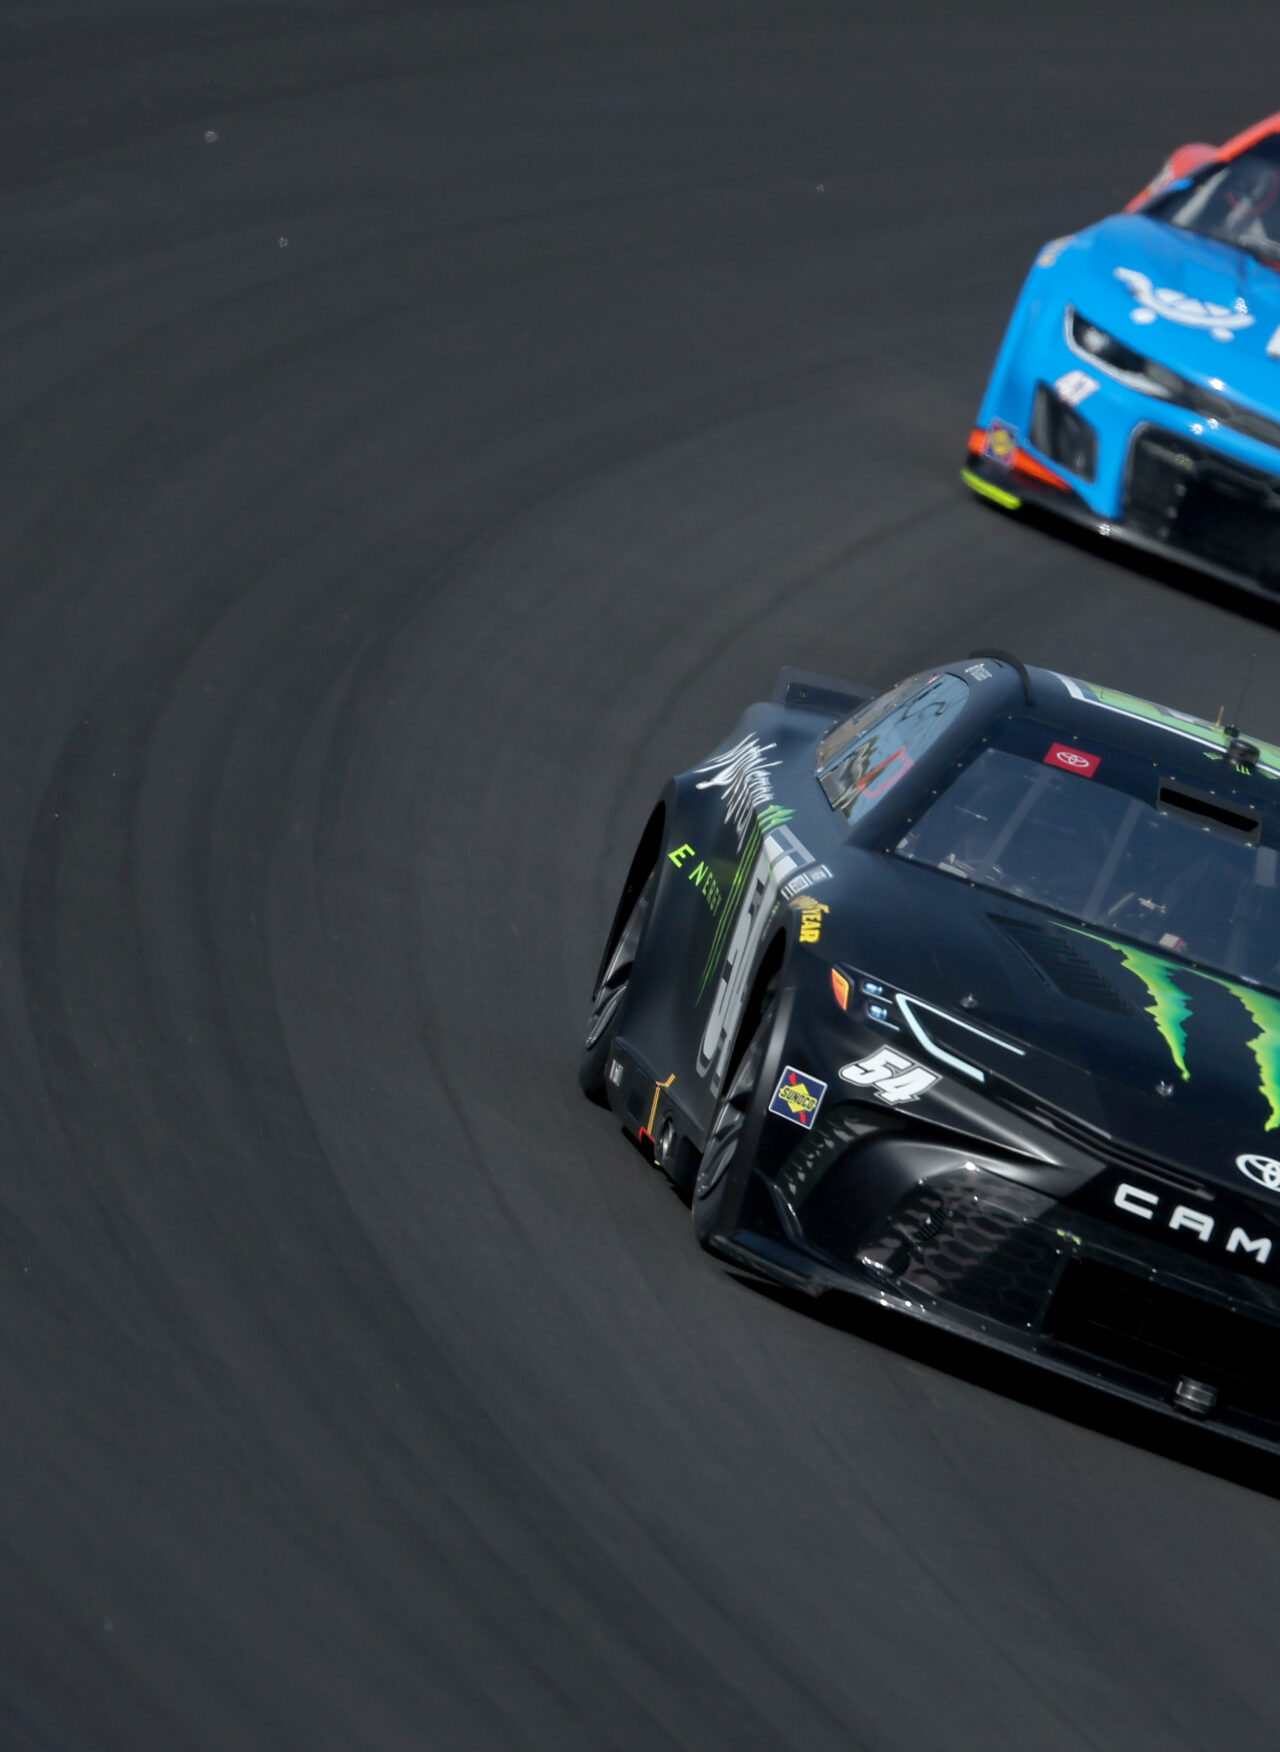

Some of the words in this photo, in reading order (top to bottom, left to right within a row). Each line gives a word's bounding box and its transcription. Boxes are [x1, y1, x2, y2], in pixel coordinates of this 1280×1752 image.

[668, 842, 723, 917] ENERGY
[780, 1087, 816, 1111] SUNOCO
[839, 1045, 942, 1105] 54
